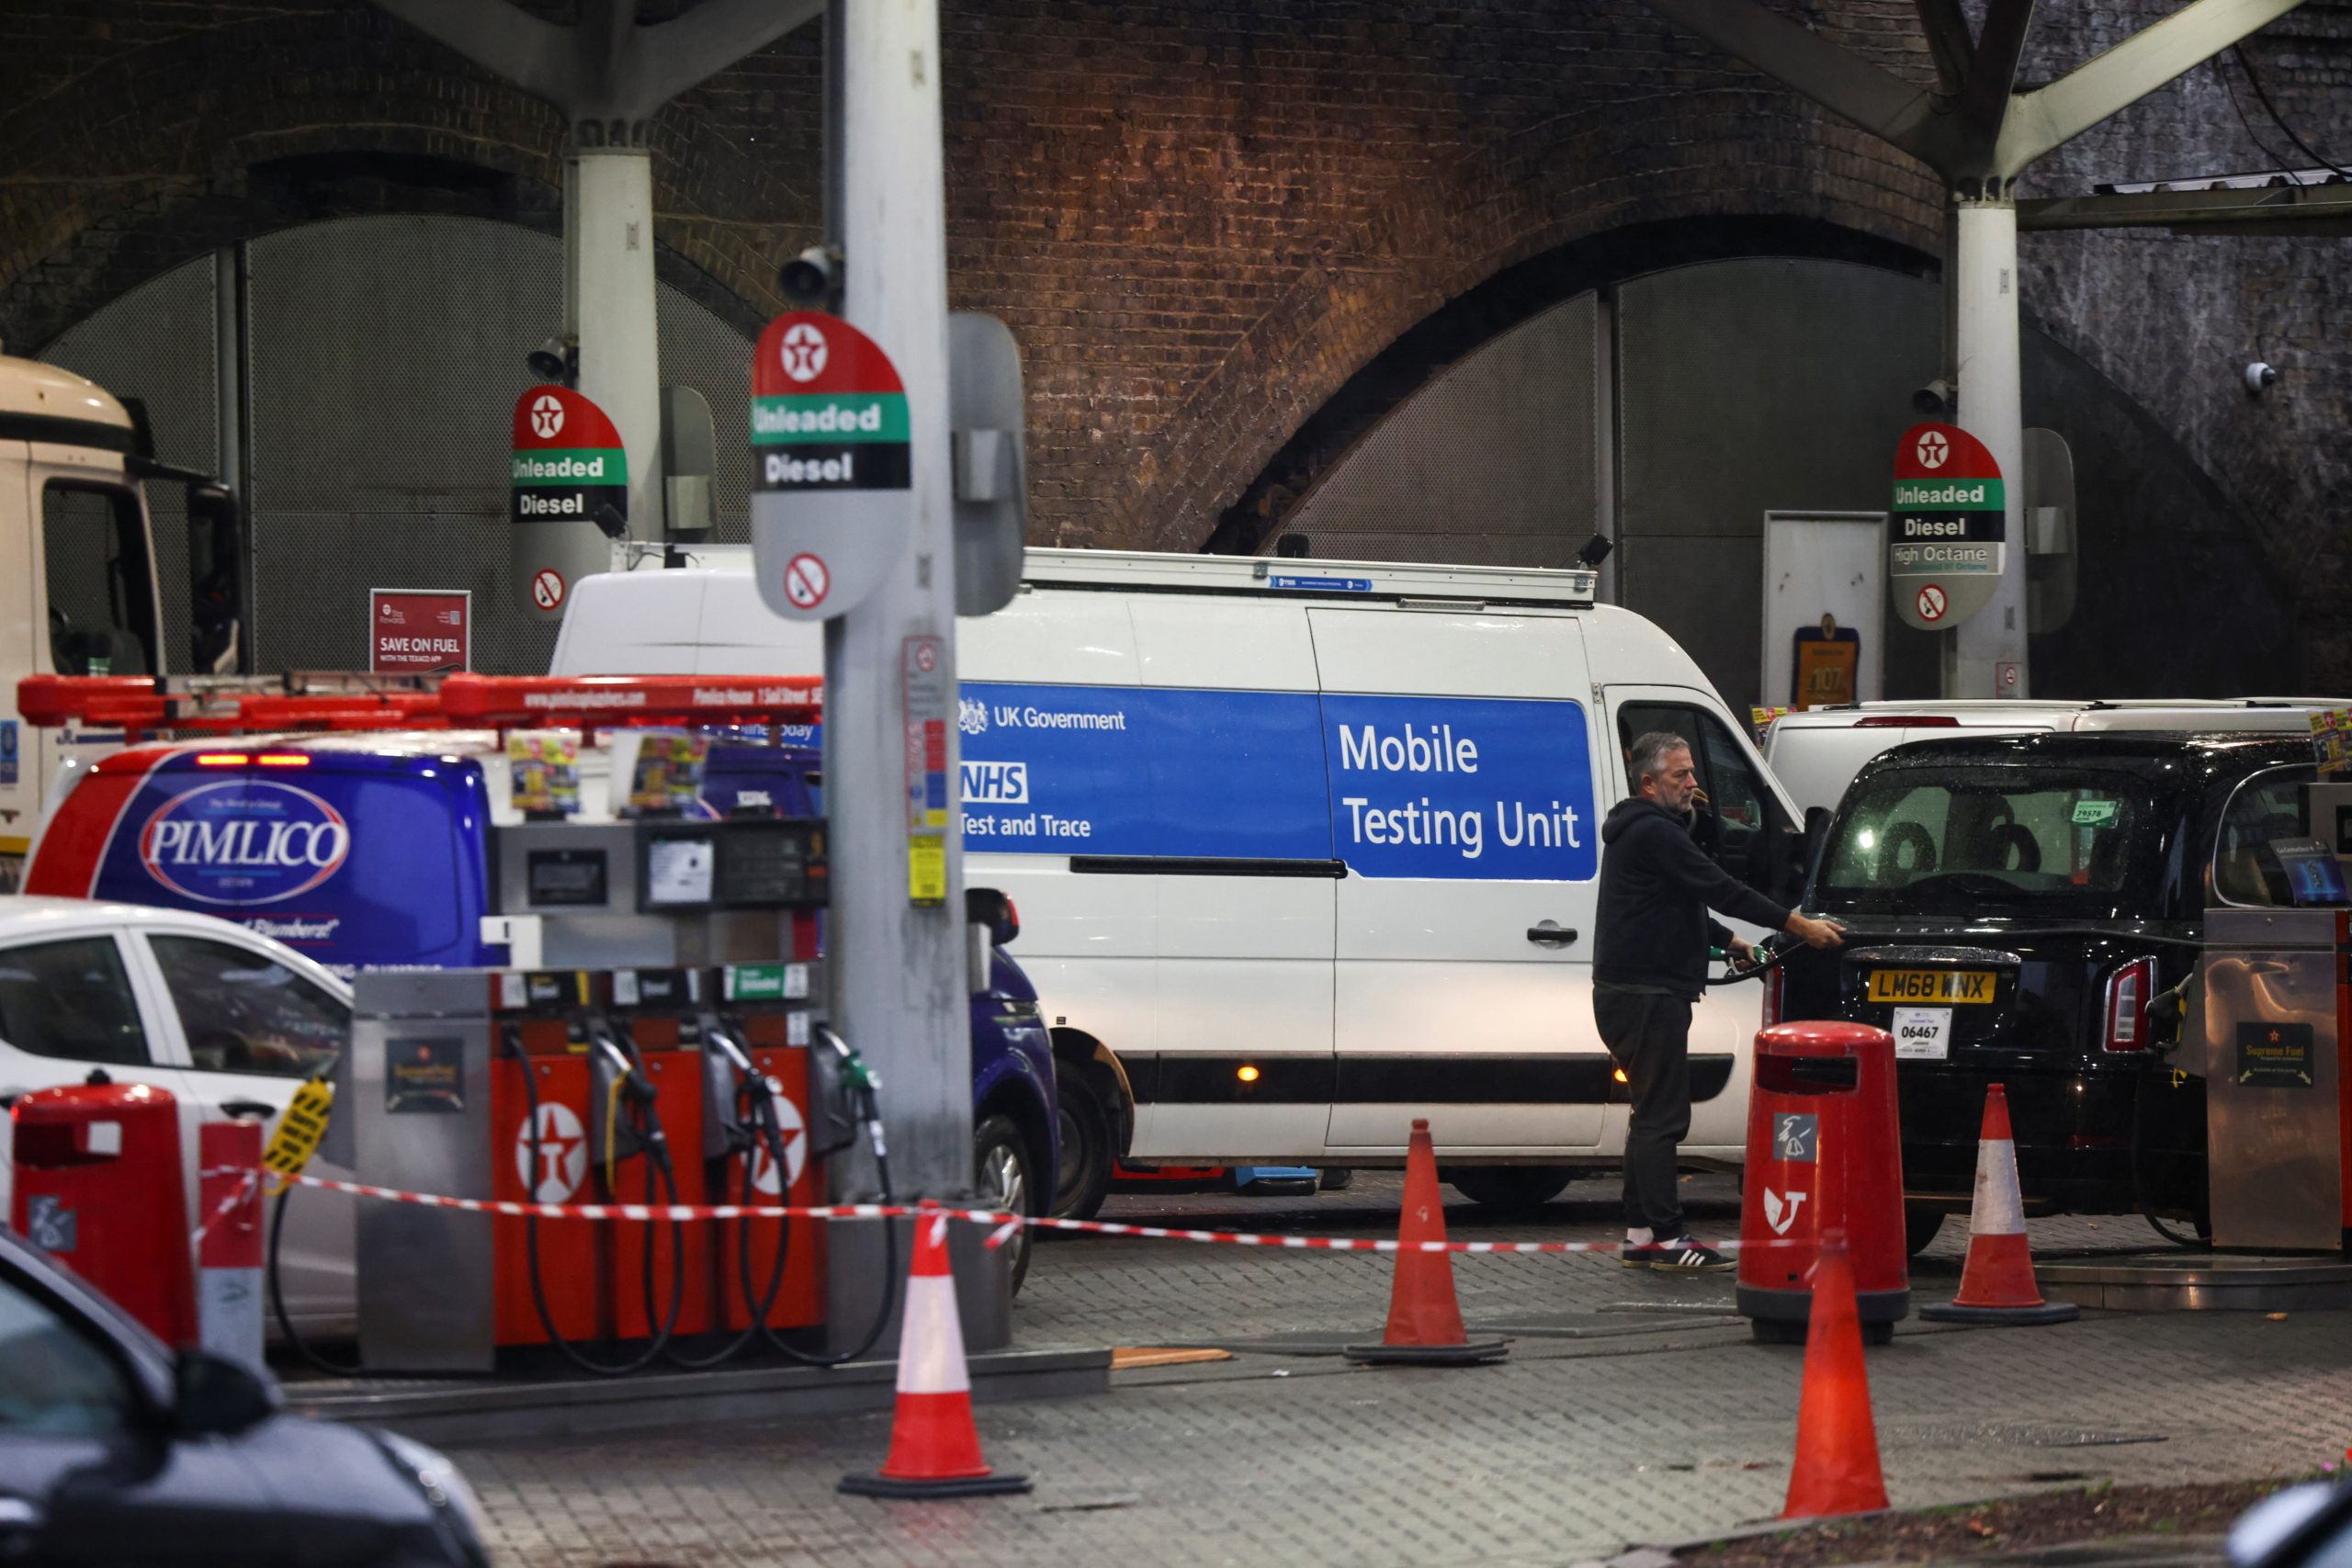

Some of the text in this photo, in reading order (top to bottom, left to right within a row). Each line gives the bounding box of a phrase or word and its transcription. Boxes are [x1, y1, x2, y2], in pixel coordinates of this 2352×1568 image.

[754, 403, 881, 434] Unleaded
[513, 457, 604, 479] Unleaded
[765, 452, 853, 483] Diesel
[520, 493, 583, 514] Diesel
[1896, 485, 1984, 504] Unleaded
[1905, 517, 1965, 536] Diesel
[1894, 547, 1987, 565] High Octane
[380, 637, 460, 653] SAVE ON FUEL
[994, 706, 1126, 730] UK Government
[1339, 723, 1478, 773] Mobile
[960, 765, 1023, 799] NHS
[960, 813, 1091, 837] Test and Trace
[1342, 796, 1580, 859] Testing Unit
[147, 819, 349, 867] PIMLICO
[1878, 974, 1986, 998] LM68 WNX
[1902, 1026, 1939, 1038] 06467
[2245, 1044, 2304, 1058] Supreme Fuel
